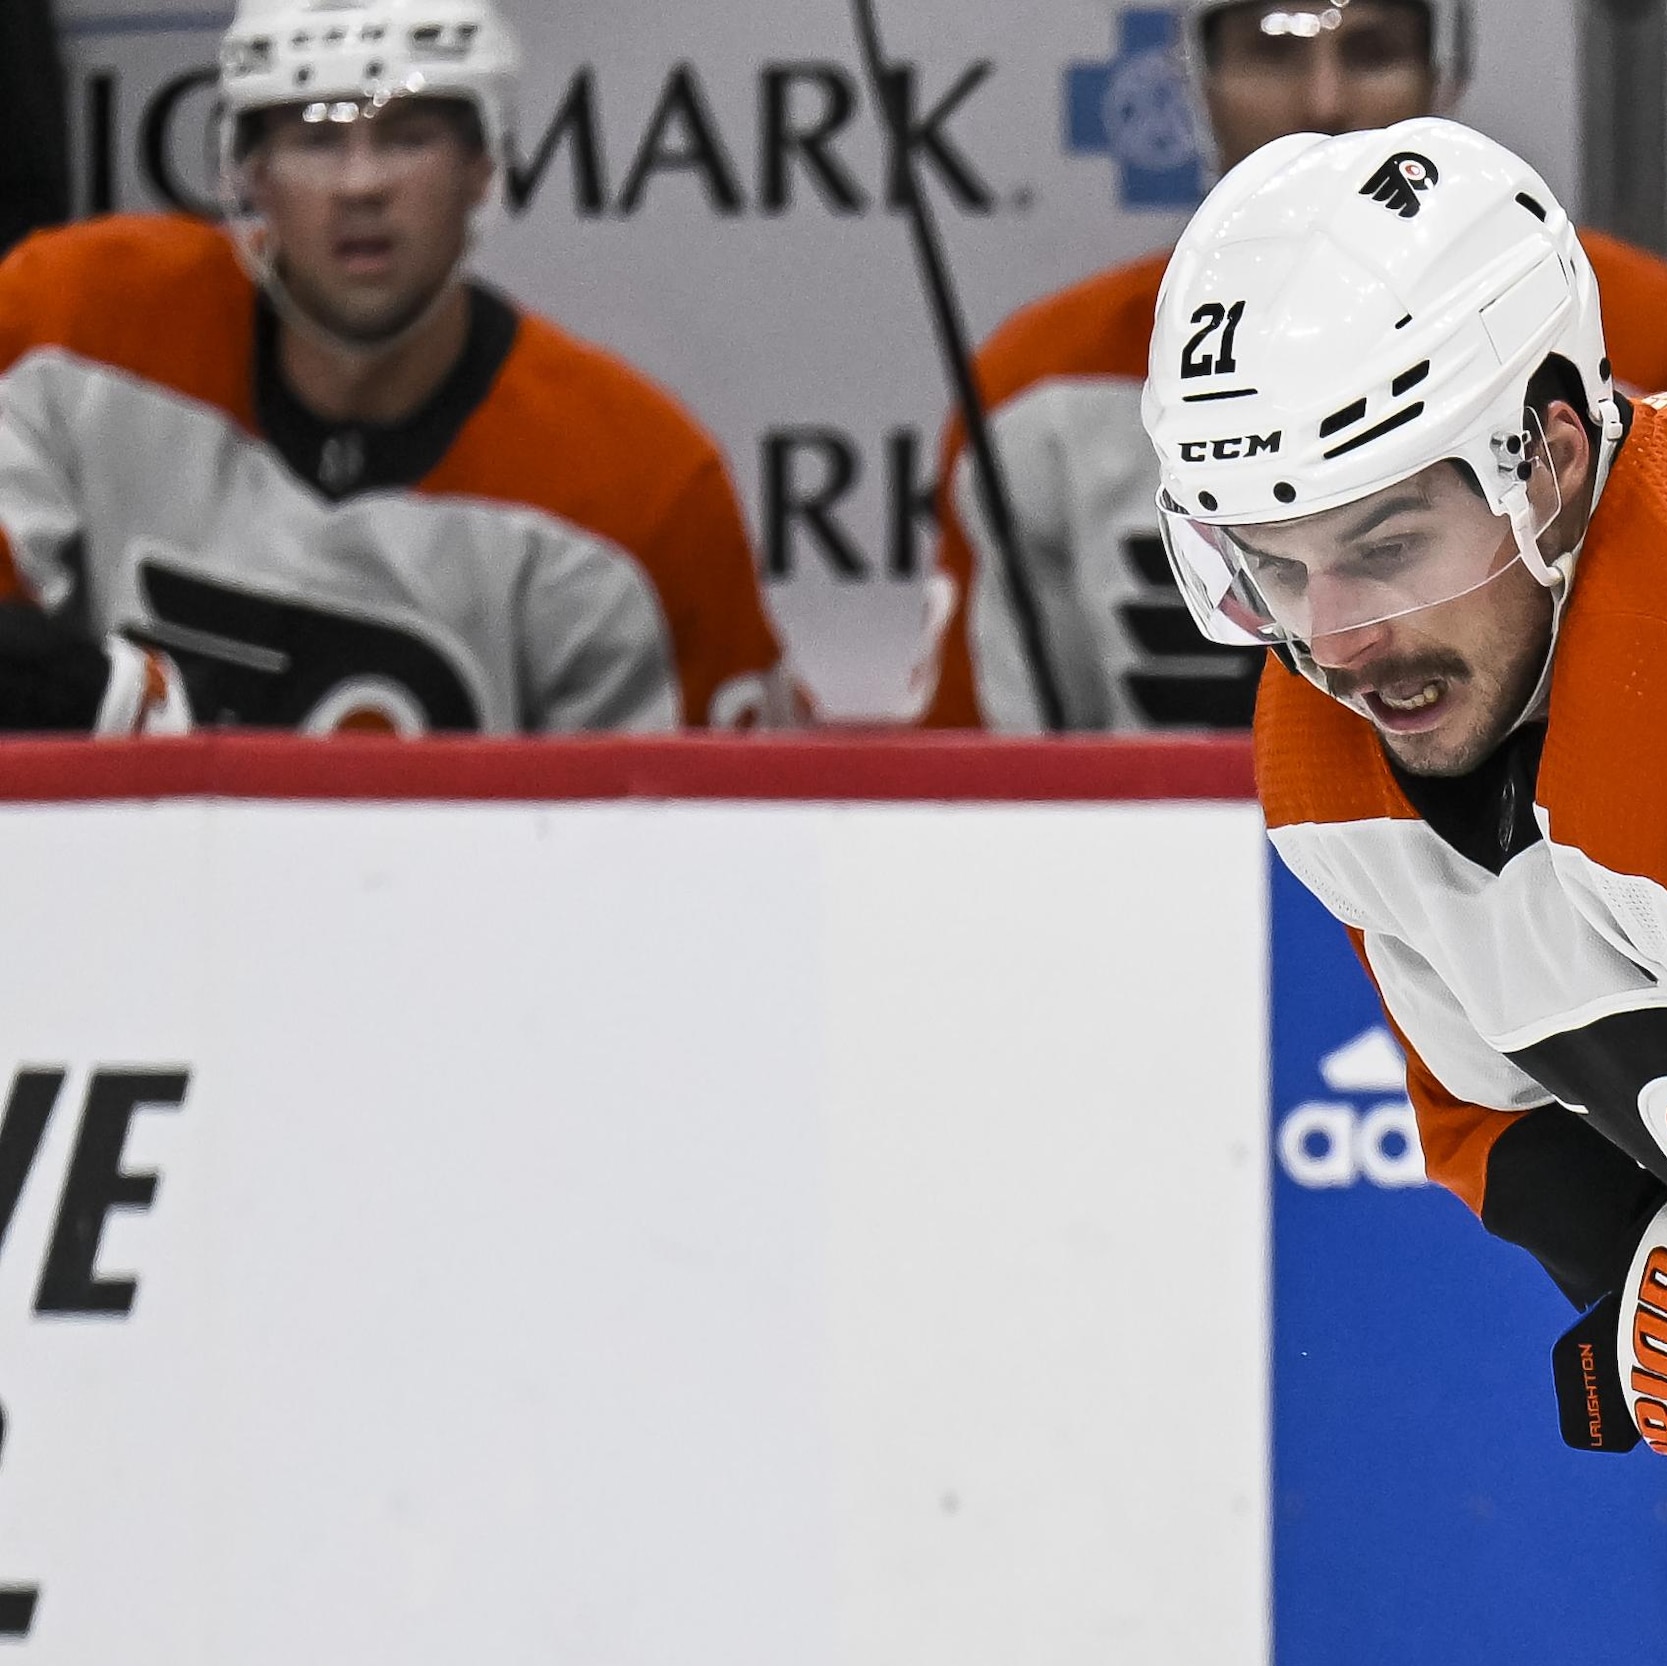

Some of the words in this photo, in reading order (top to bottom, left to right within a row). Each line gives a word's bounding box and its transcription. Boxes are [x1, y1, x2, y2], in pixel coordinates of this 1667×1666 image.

[1181, 300, 1246, 379] 21
[1178, 430, 1282, 462] CCM
[1579, 1343, 1603, 1447] LAUGHTON
